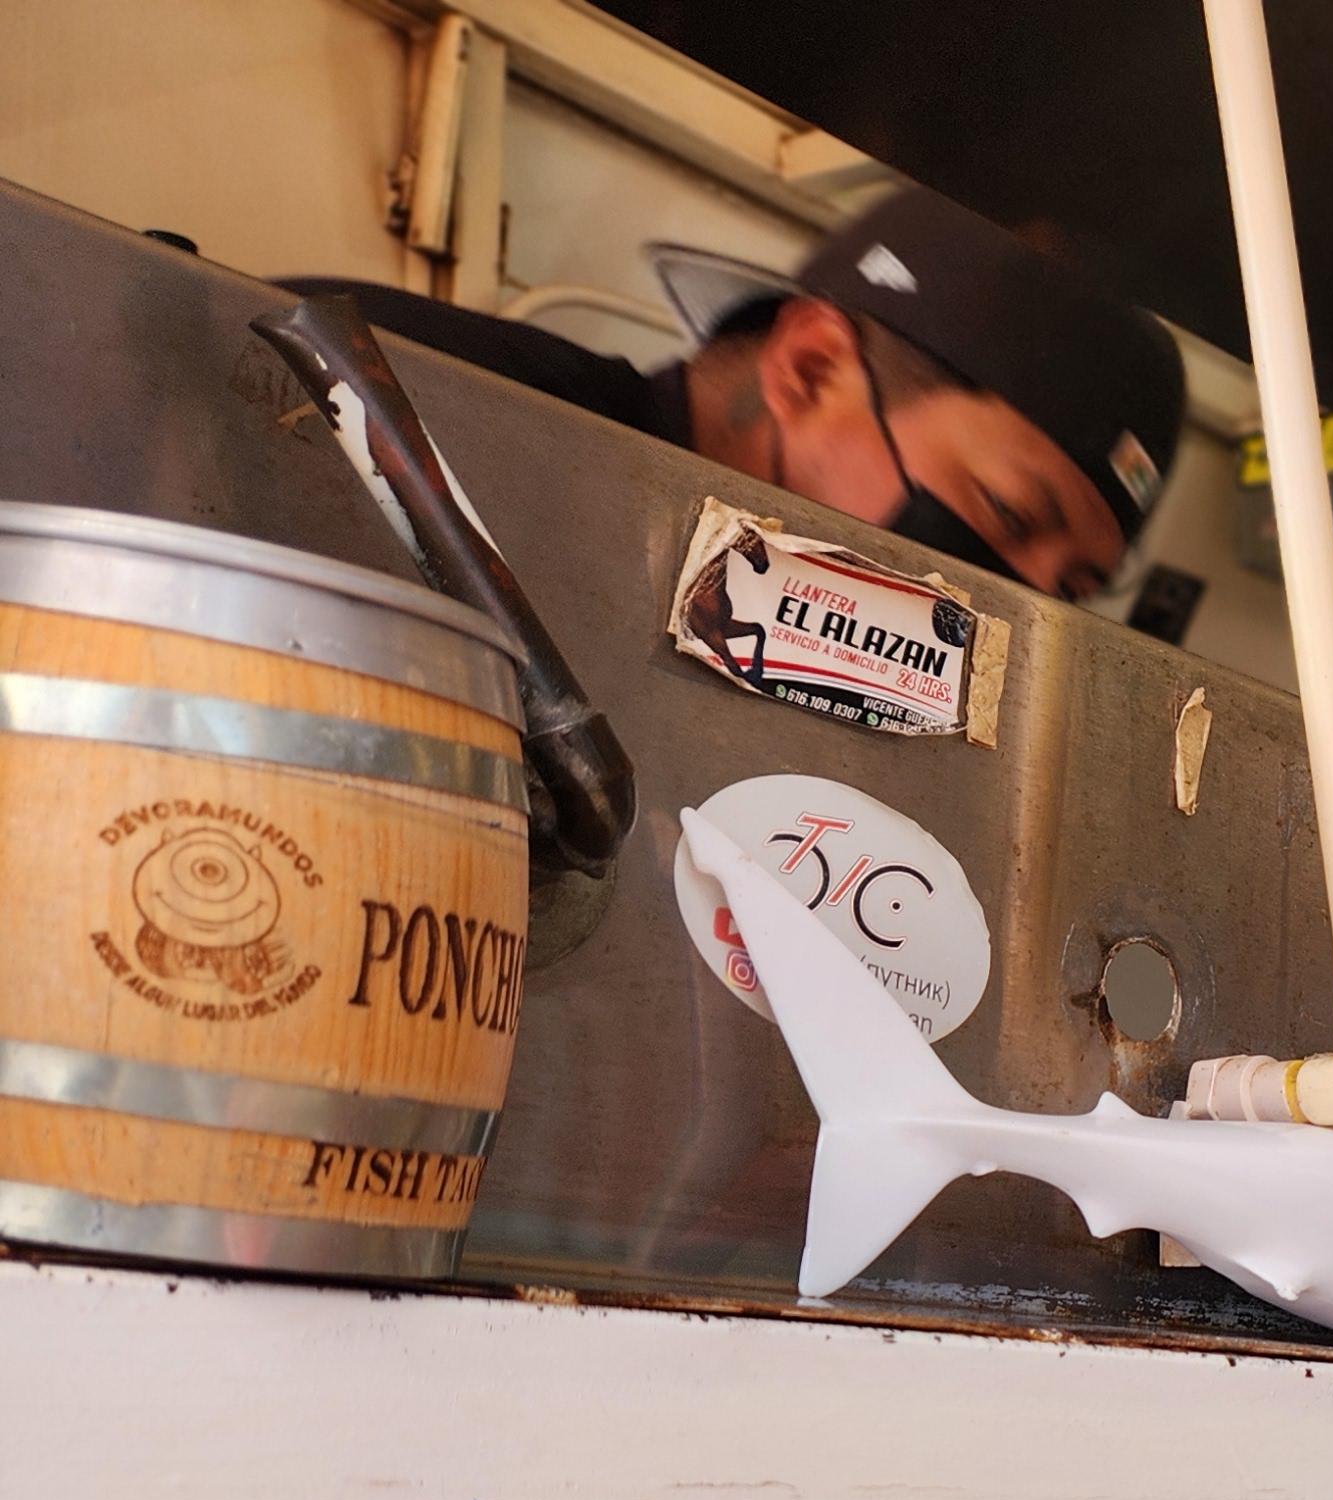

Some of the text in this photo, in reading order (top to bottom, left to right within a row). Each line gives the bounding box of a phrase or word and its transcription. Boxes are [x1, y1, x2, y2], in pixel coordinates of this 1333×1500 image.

[781, 576, 858, 616] LLANTERA
[769, 626, 889, 675] SERVICIO A DOMICILIO
[775, 595, 948, 678] EL ALAZAN
[786, 688, 863, 721] 616.109.0307
[863, 696, 905, 718] VICENTE
[895, 667, 953, 704] 24 HRS.
[98, 798, 324, 889] DEVORAMUNDOS
[302, 1139, 431, 1201] FISH
